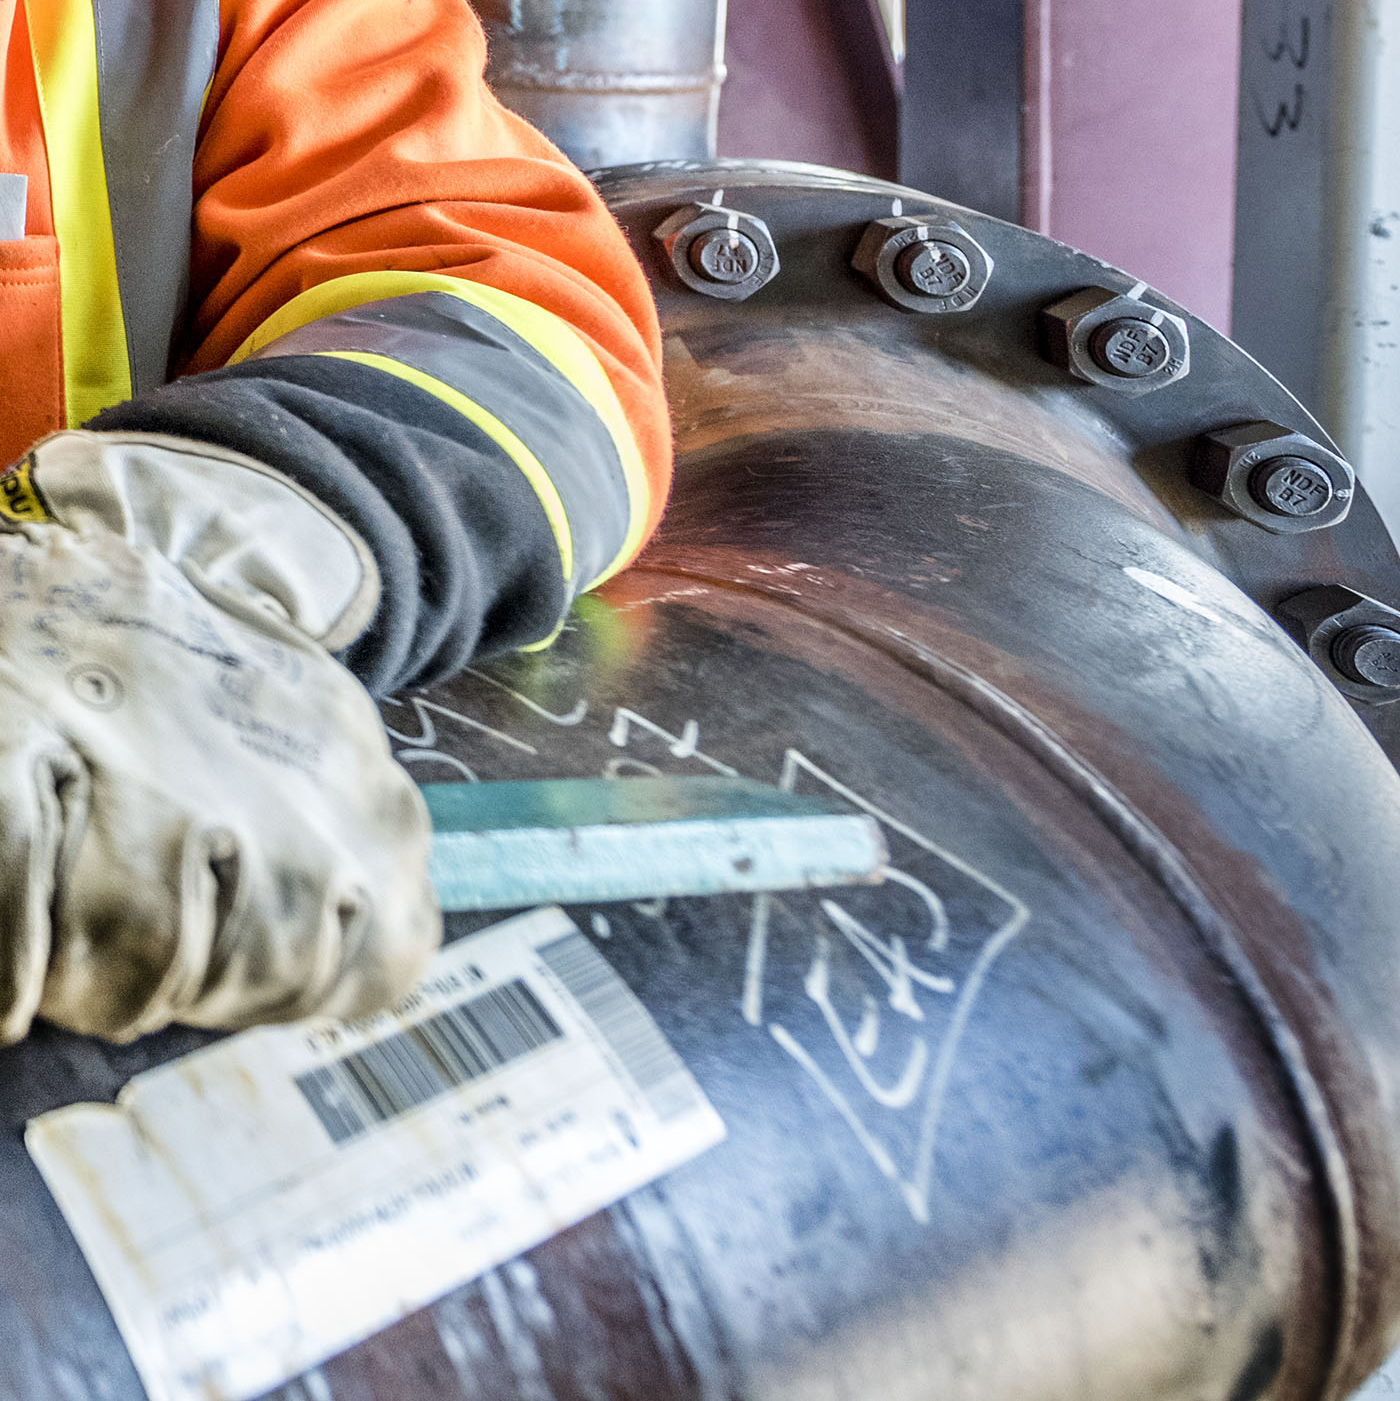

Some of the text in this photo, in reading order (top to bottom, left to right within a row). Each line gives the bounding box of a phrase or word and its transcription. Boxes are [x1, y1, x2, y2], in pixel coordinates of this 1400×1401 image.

[1111, 329, 1141, 364] NDF
[1135, 343, 1159, 366] B7
[1282, 469, 1328, 496] NDF
[1278, 487, 1308, 506] B7
